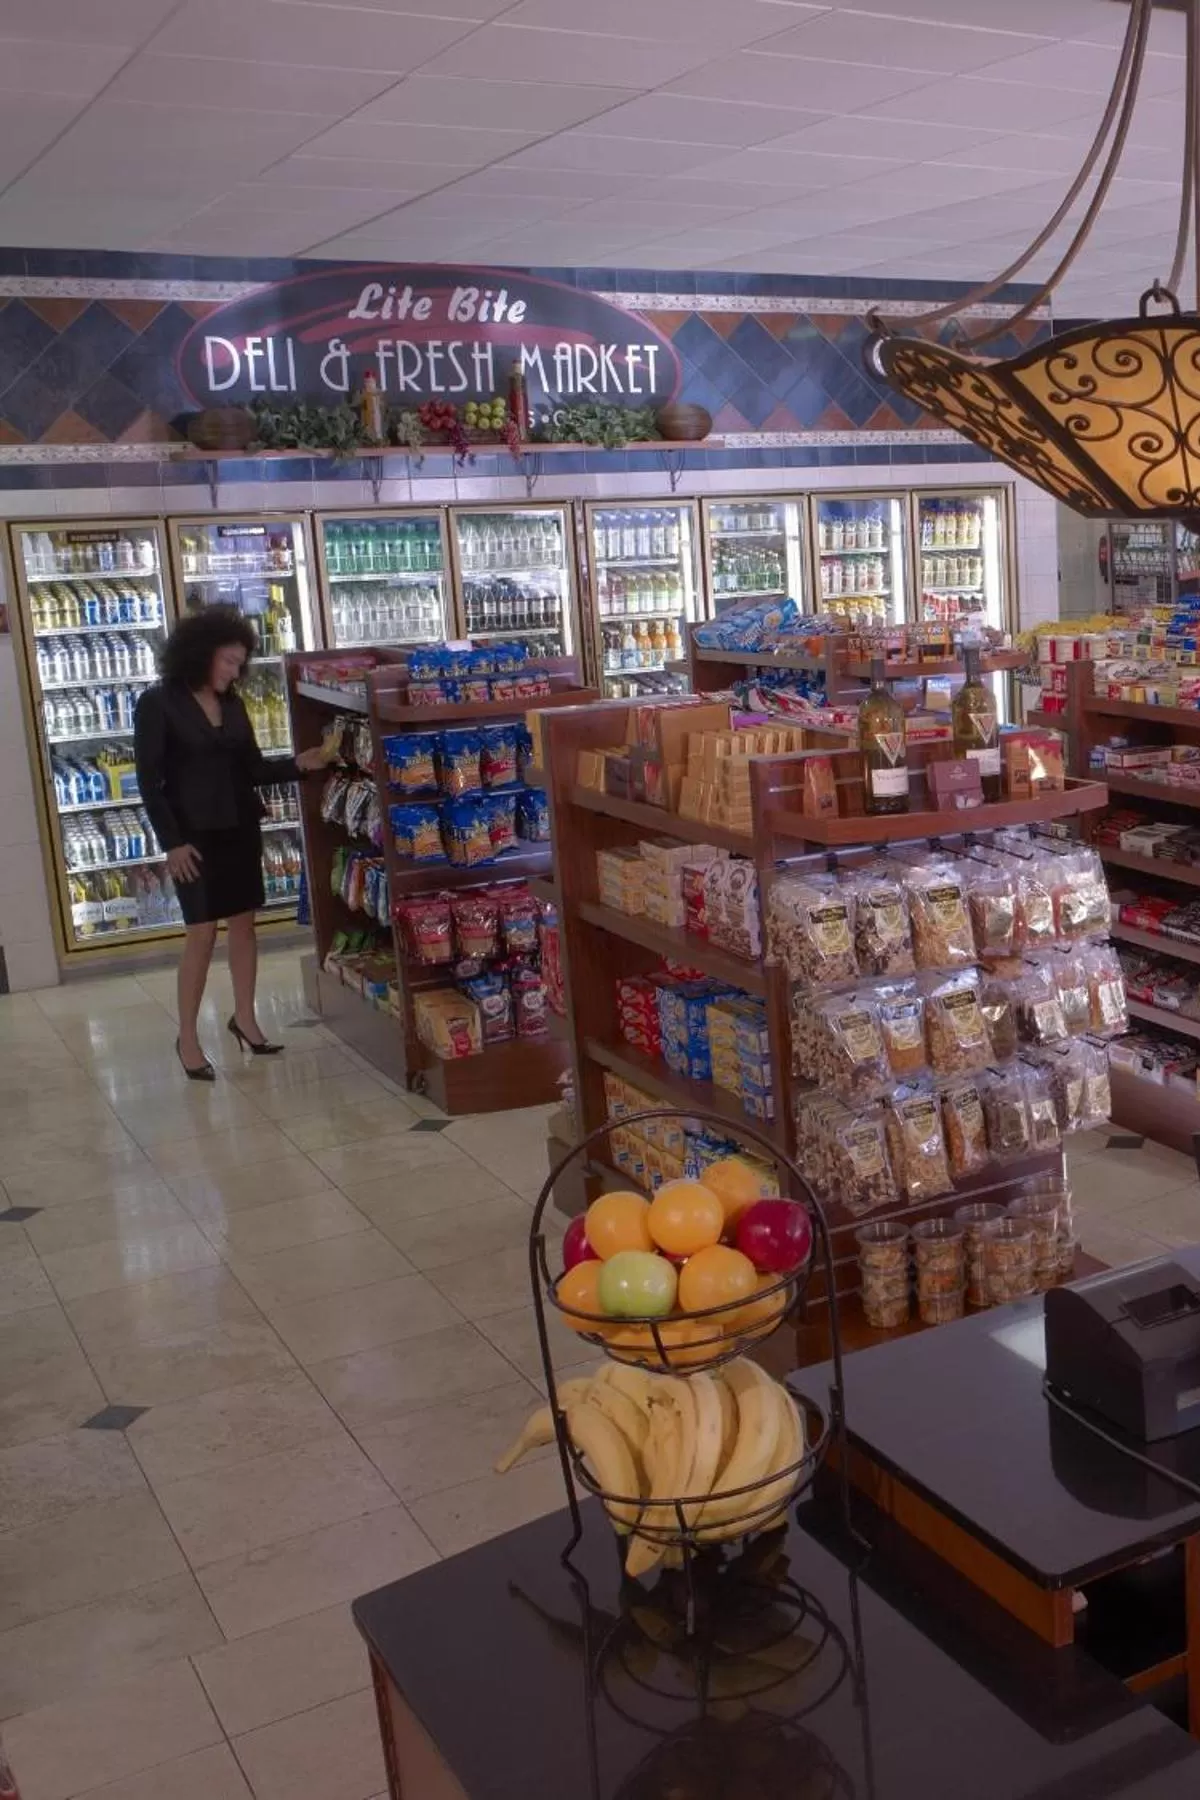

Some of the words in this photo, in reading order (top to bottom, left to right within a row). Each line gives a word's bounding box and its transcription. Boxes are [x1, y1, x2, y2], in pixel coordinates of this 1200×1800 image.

[348, 282, 432, 320] Lite
[448, 286, 527, 323] Bite
[204, 336, 297, 391] DELI
[320, 338, 351, 391] &
[375, 339, 495, 393] FRESH
[520, 343, 659, 393] MARKET
